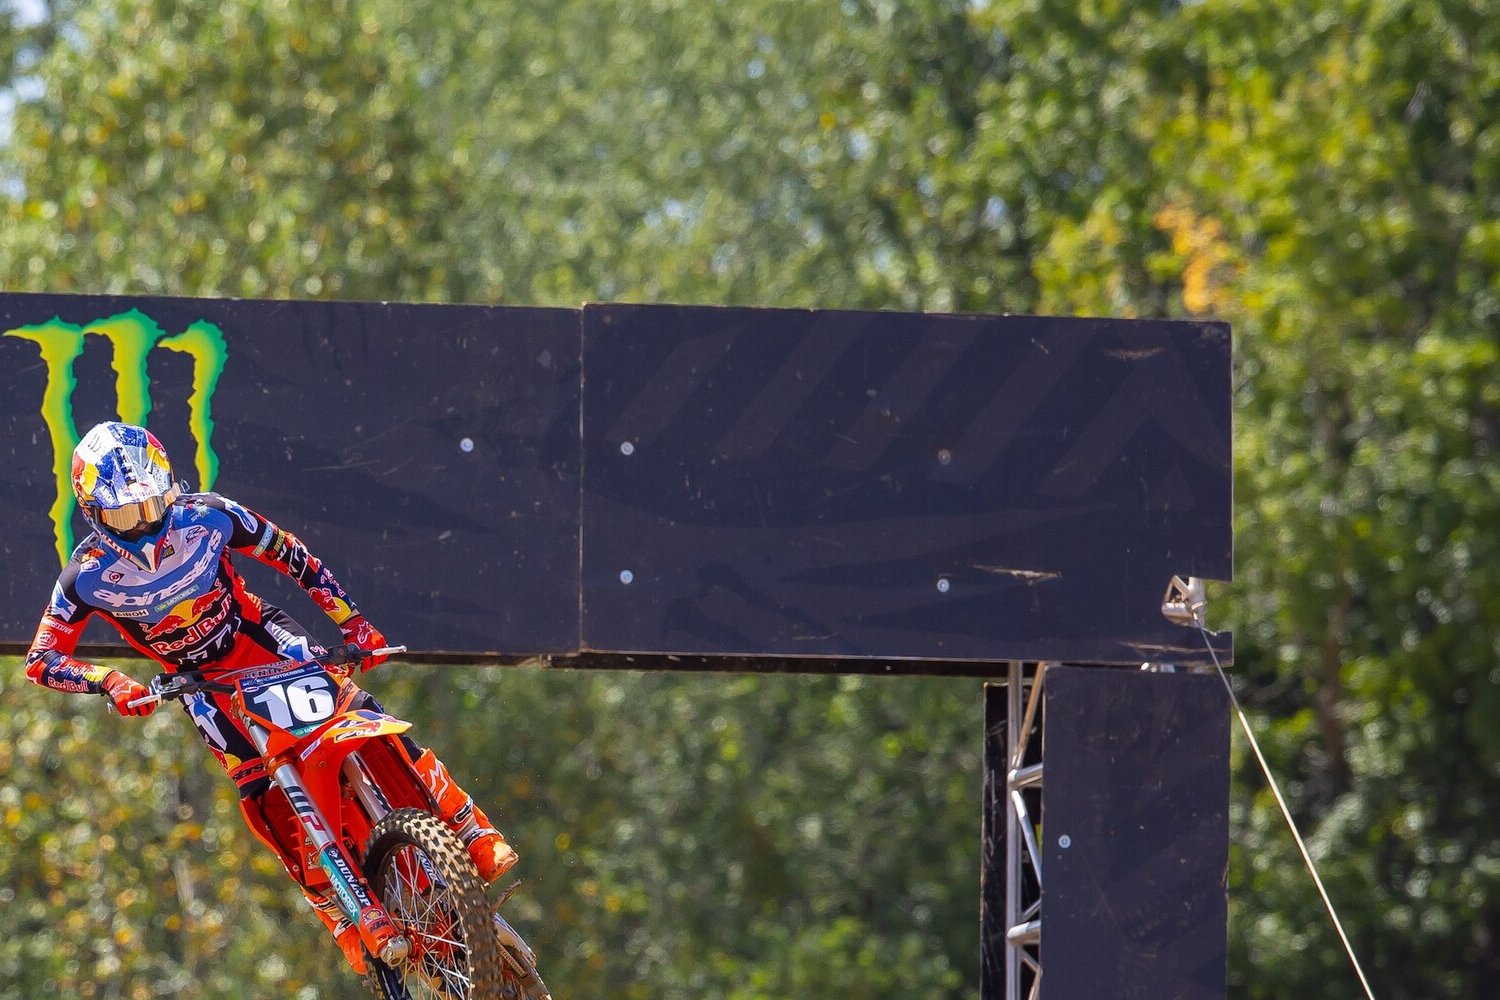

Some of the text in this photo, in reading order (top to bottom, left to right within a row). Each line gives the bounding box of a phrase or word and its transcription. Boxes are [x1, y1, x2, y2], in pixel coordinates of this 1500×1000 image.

[150, 627, 201, 655] Red
[196, 593, 232, 637] Bull
[47, 676, 89, 692] Red Bull
[253, 676, 334, 729] 16
[330, 873, 358, 916] MOTOREX
